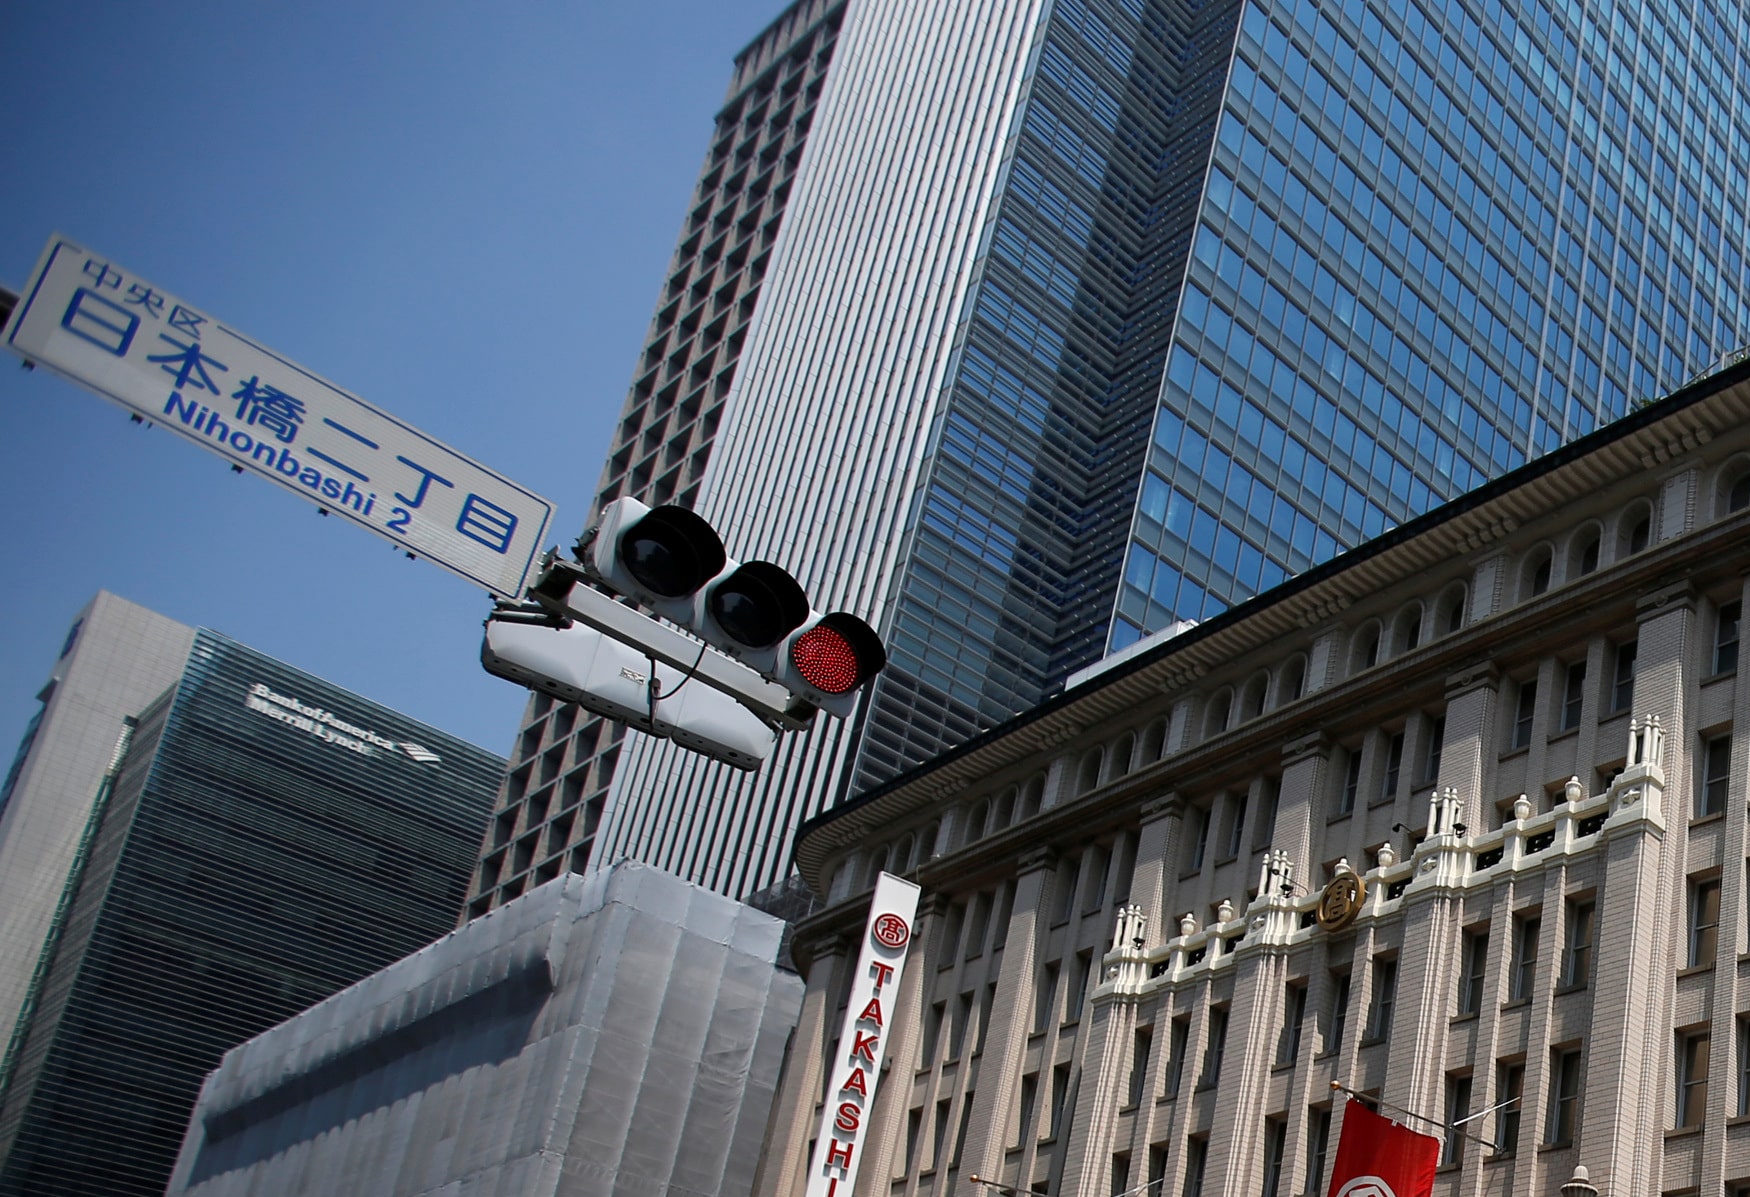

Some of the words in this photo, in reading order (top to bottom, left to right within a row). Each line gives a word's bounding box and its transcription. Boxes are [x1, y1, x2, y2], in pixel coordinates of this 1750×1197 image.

[82, 257, 209, 336] 中央区
[60, 286, 518, 554] 日本橋二丁目
[163, 391, 377, 517] Nihonbashi
[386, 507, 412, 535] 2
